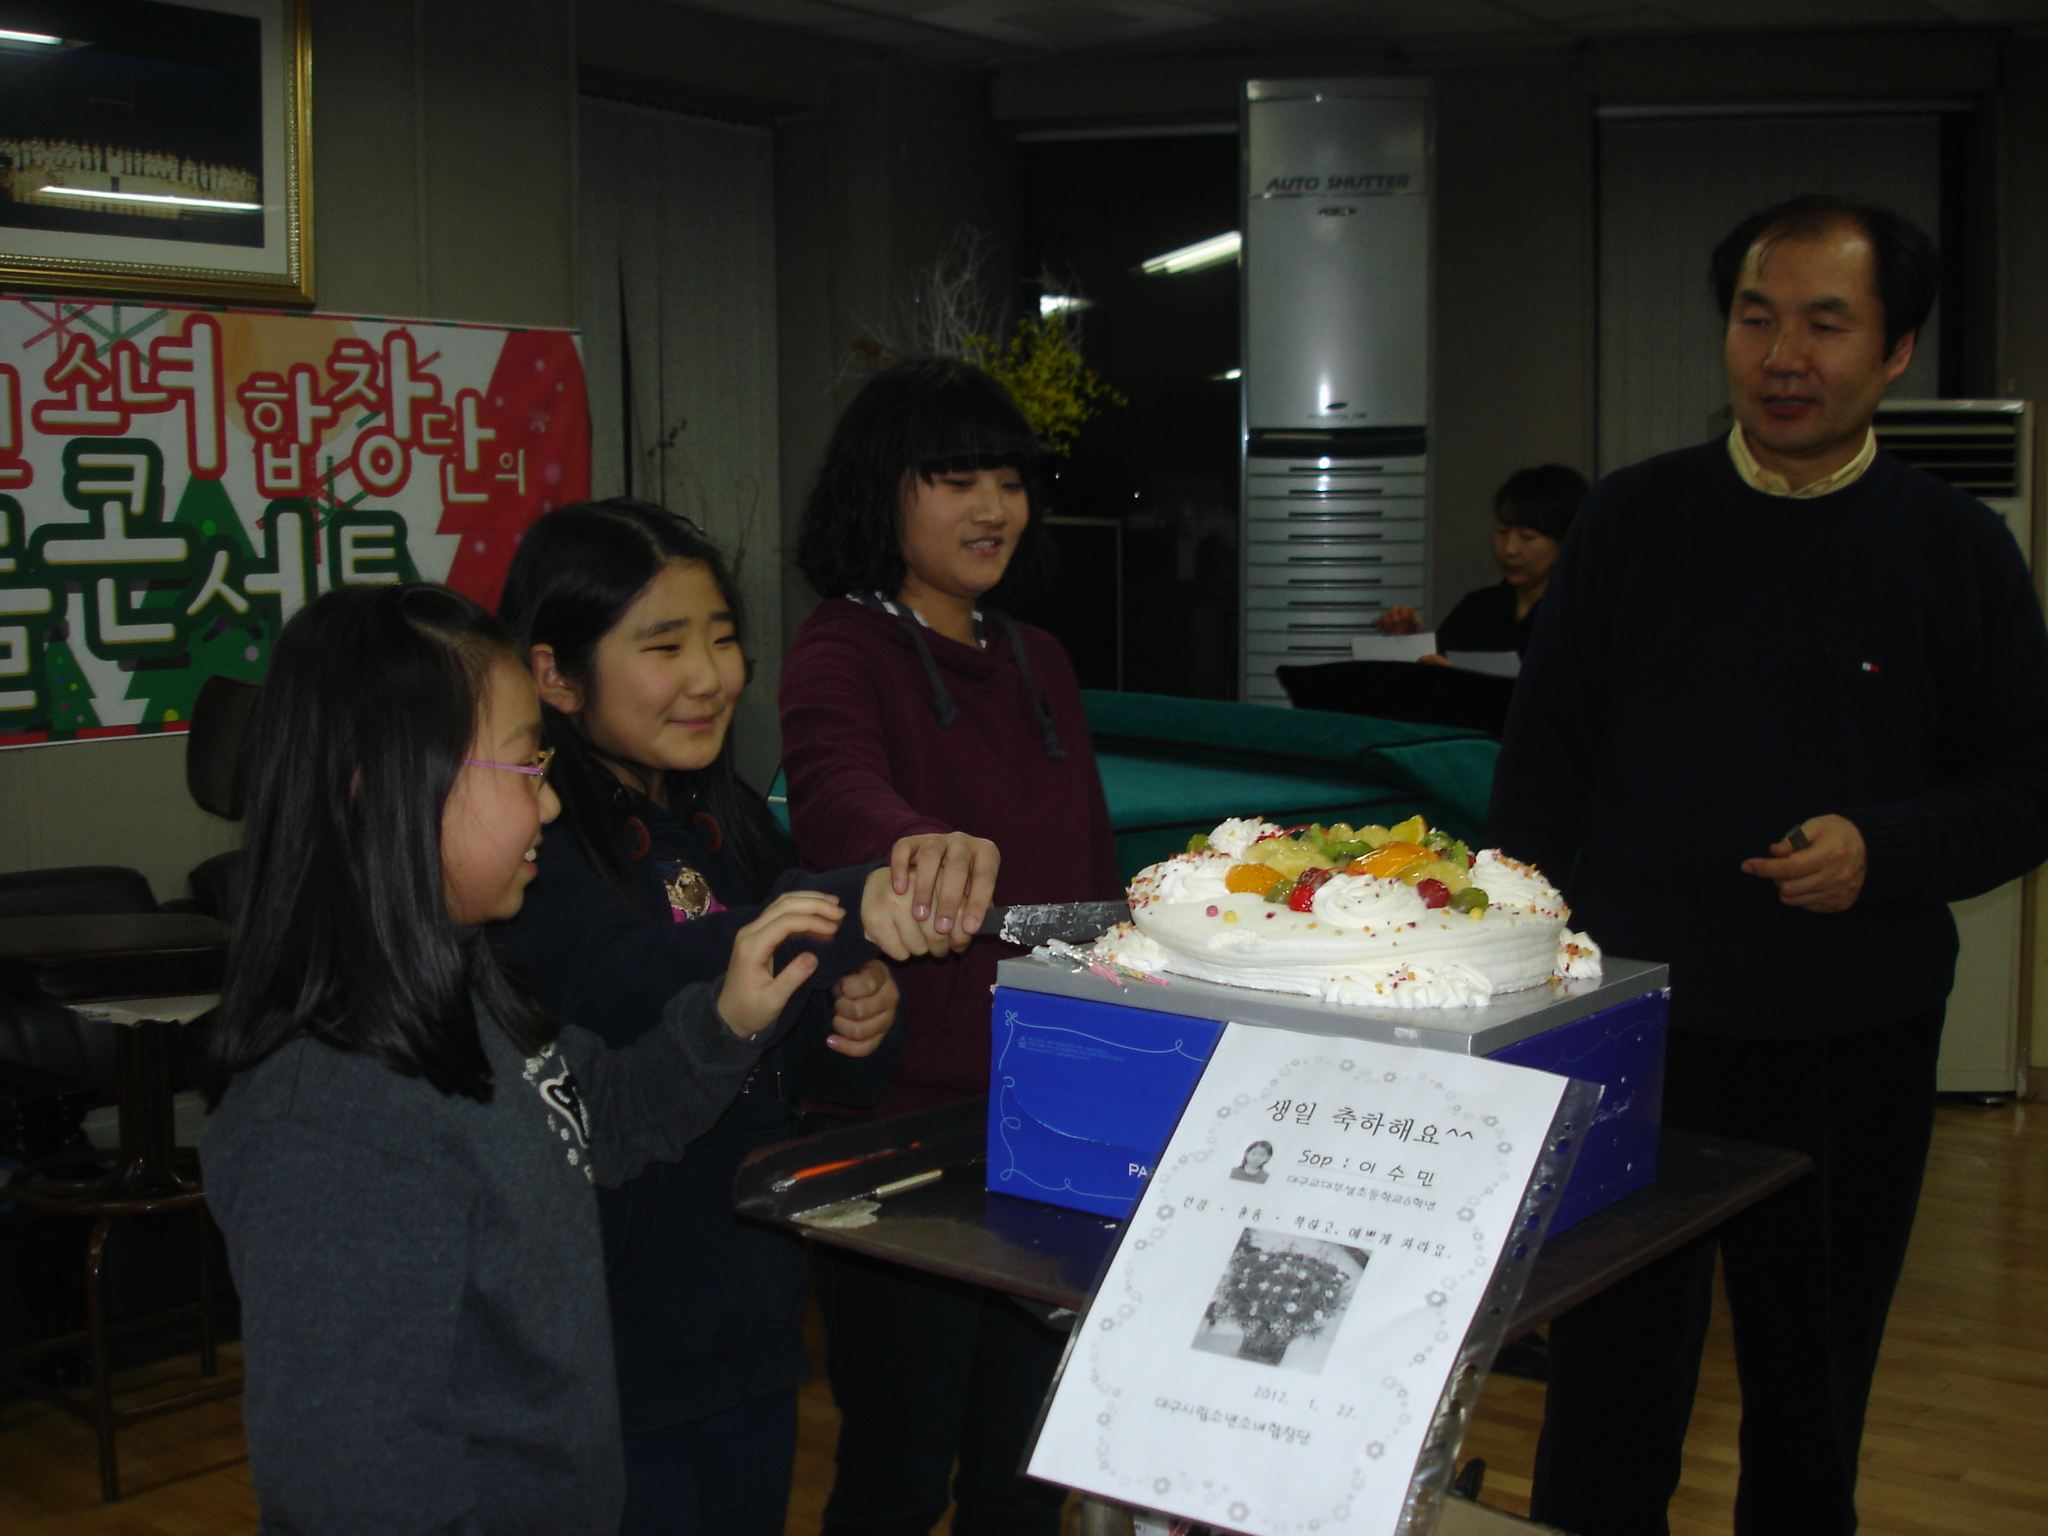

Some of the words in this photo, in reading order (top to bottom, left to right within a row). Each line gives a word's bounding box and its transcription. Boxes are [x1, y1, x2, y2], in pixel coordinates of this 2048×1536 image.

[1266, 176, 1320, 191] AUTO
[1327, 174, 1411, 190] SHUTTER
[1266, 1099, 1317, 1126] 생일
[1298, 1150, 1333, 1169] Sop
[1128, 1162, 1149, 1179] PA
